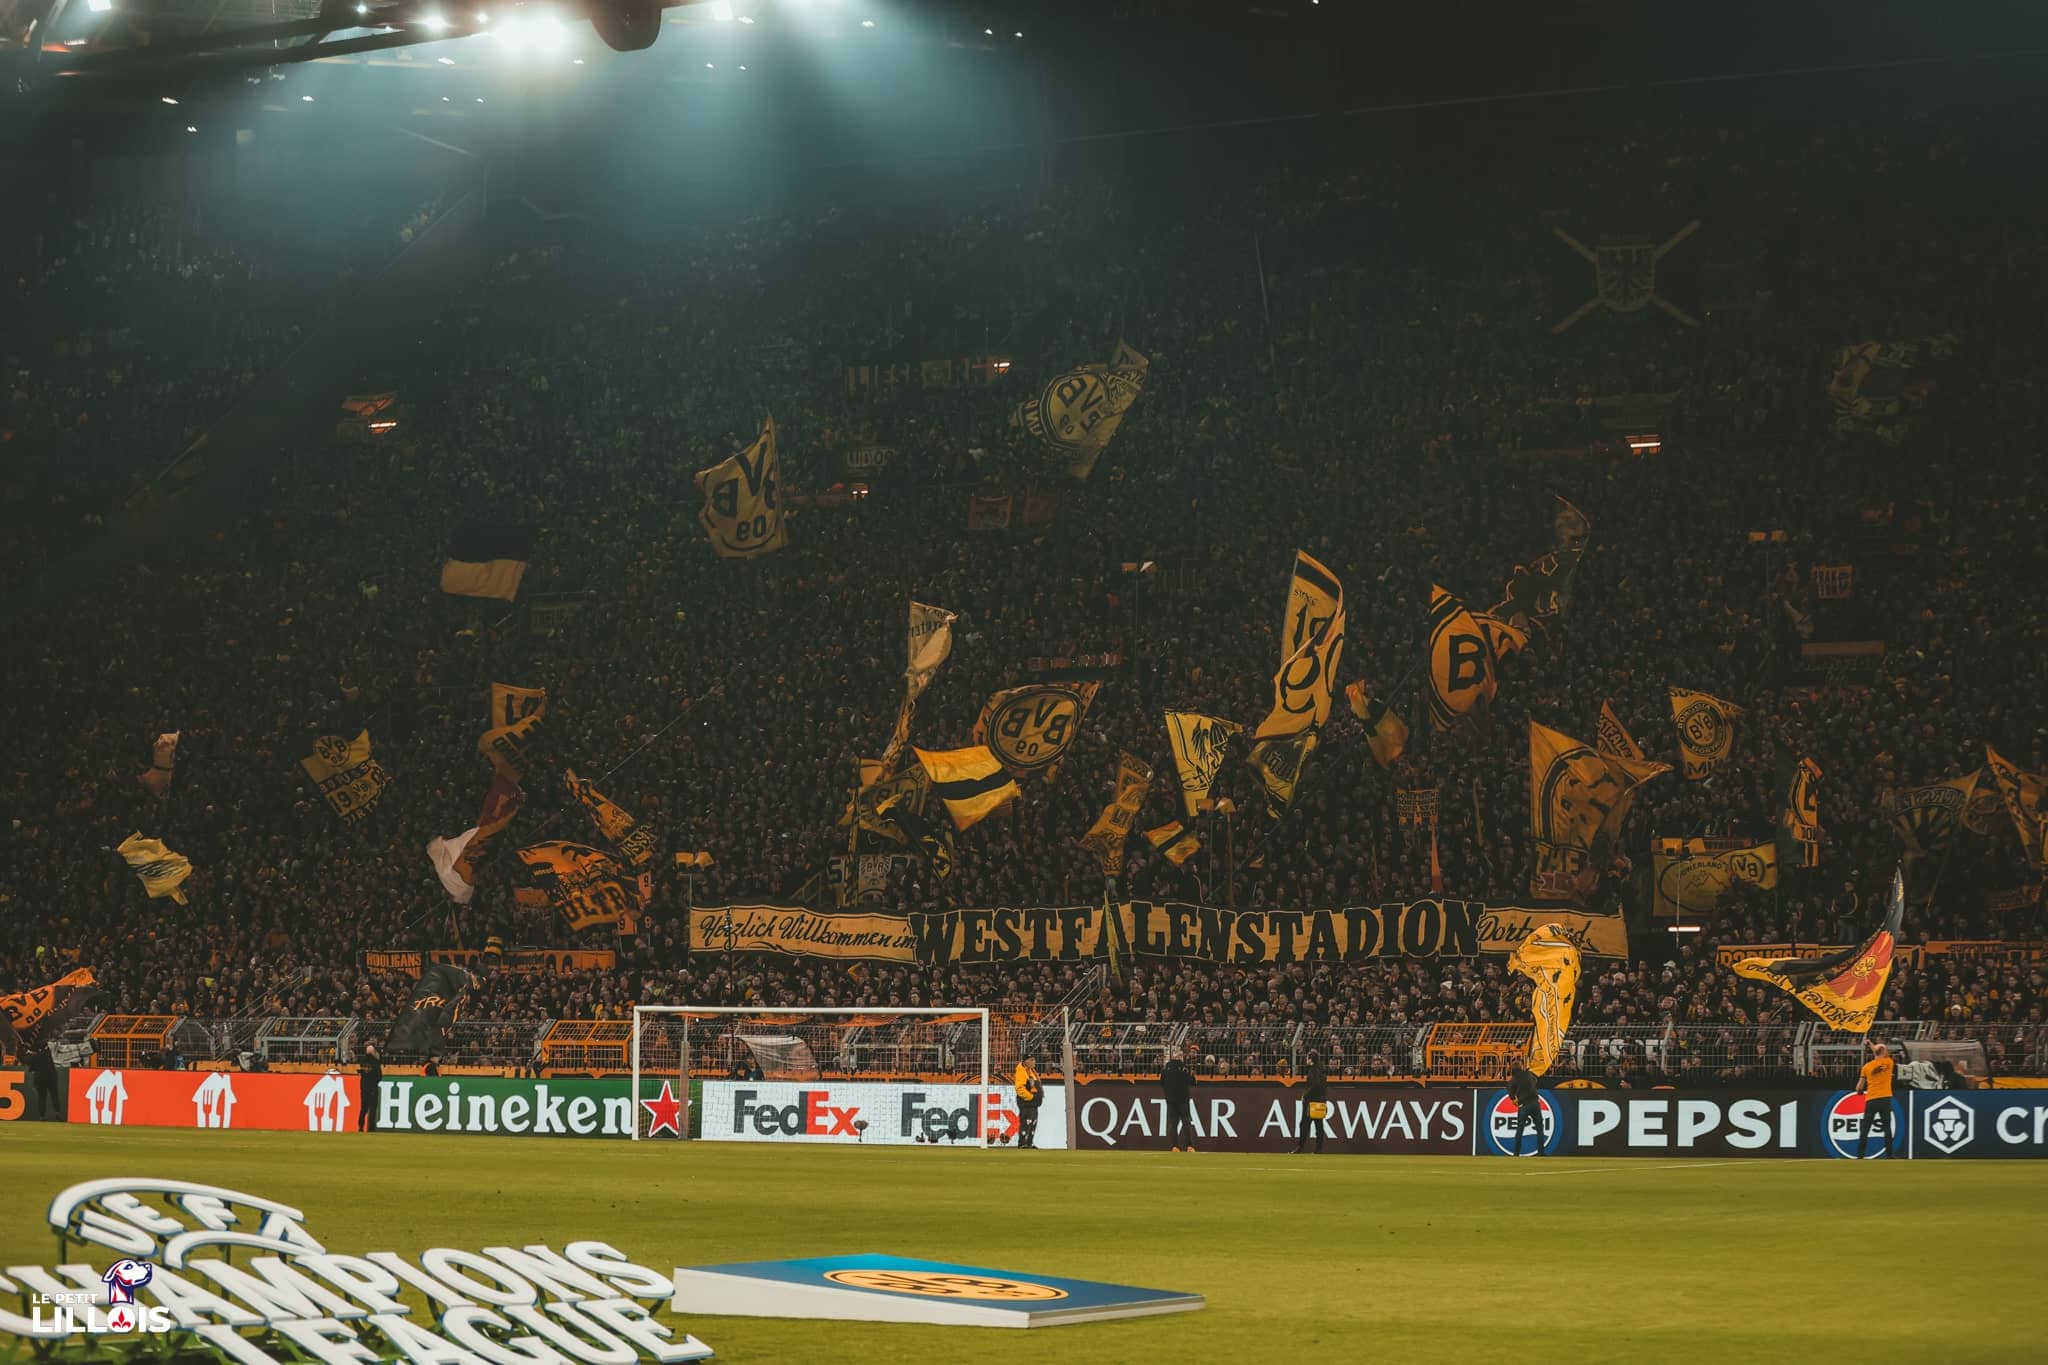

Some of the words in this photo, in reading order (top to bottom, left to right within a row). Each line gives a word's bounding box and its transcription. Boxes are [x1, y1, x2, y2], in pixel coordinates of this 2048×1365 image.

[779, 913, 891, 945] Willkommen
[909, 900, 1485, 965] WESTFALENSTADION
[366, 951, 422, 968] HOOLIGANS
[0, 1071, 26, 1121] 5
[376, 1081, 633, 1134] Heineken
[733, 1090, 861, 1136] FedEx
[1577, 1099, 1798, 1149] PEPSI
[77, 1192, 326, 1257] UEFA
